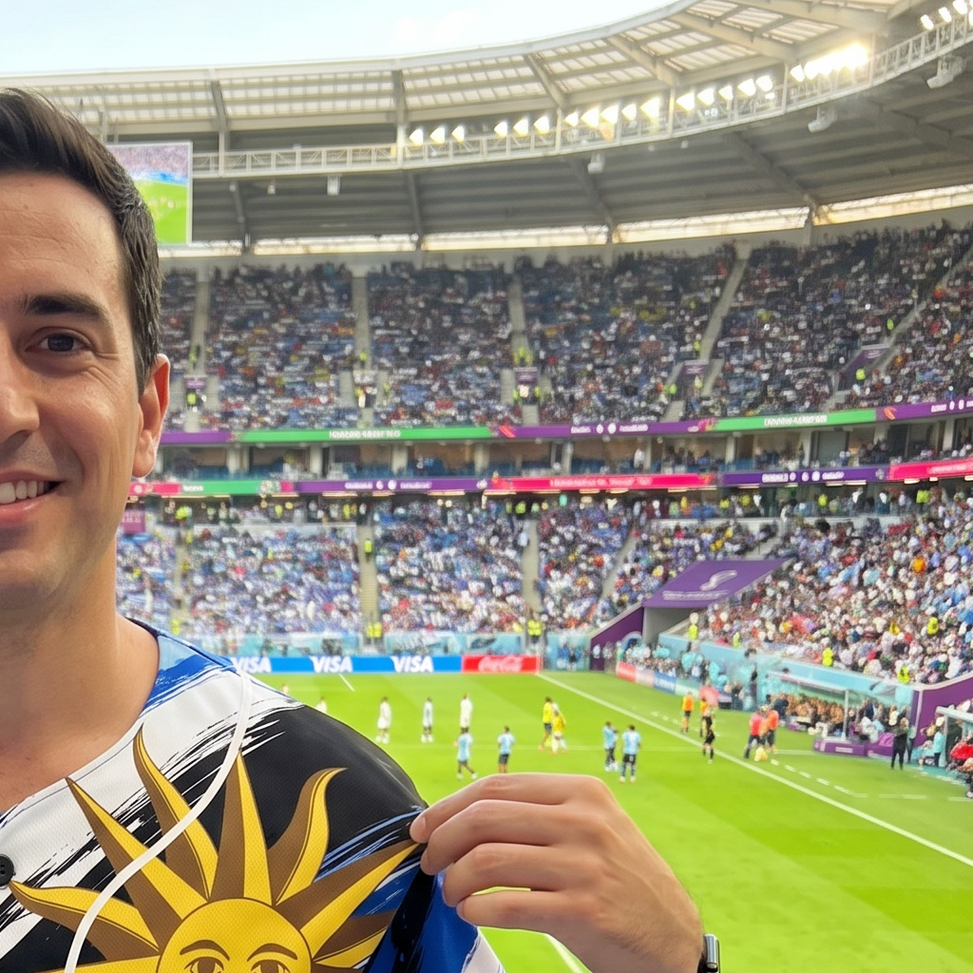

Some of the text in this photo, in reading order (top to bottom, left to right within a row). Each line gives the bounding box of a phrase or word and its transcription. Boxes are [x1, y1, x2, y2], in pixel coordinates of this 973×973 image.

[230, 656, 272, 673] VISA
[308, 656, 353, 673] VISA
[389, 656, 434, 673] VISA
